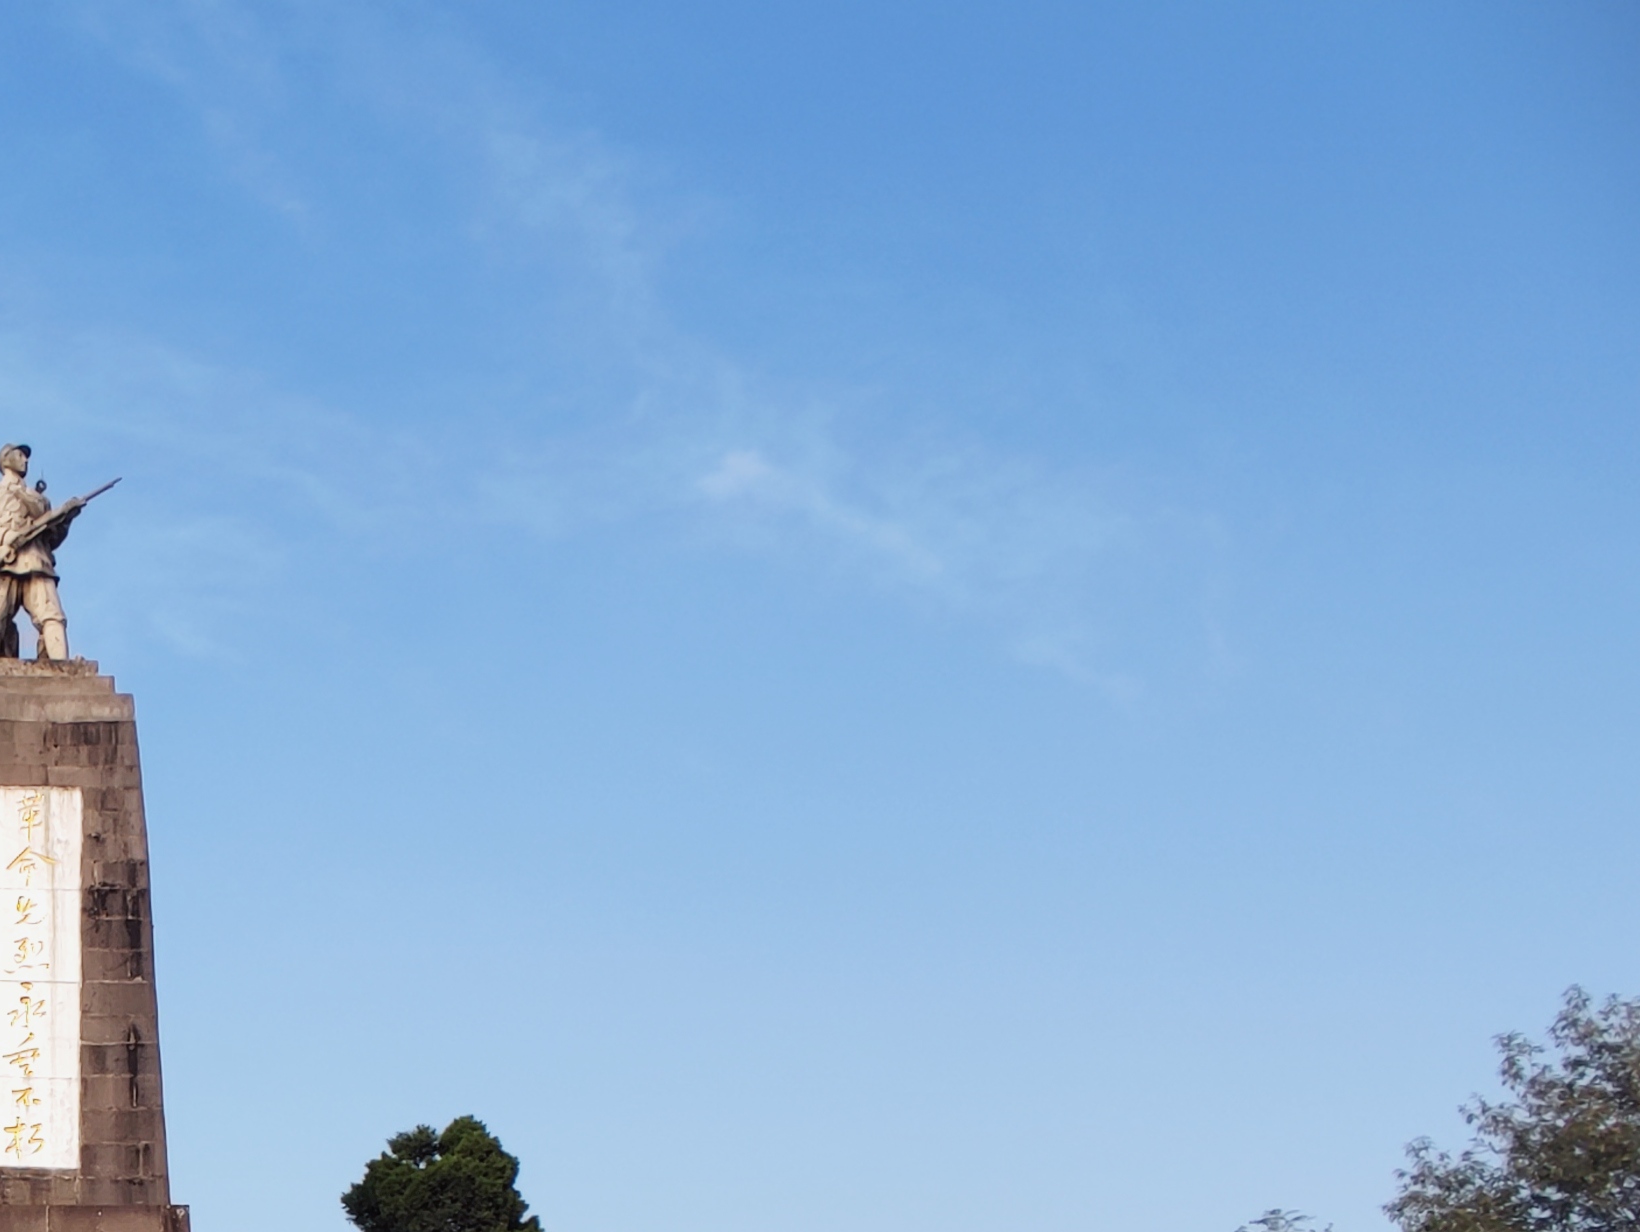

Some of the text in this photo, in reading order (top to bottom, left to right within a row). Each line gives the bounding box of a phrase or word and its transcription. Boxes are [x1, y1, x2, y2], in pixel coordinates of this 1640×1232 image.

[3, 790, 59, 1160] 革命先烈永垂不朽
